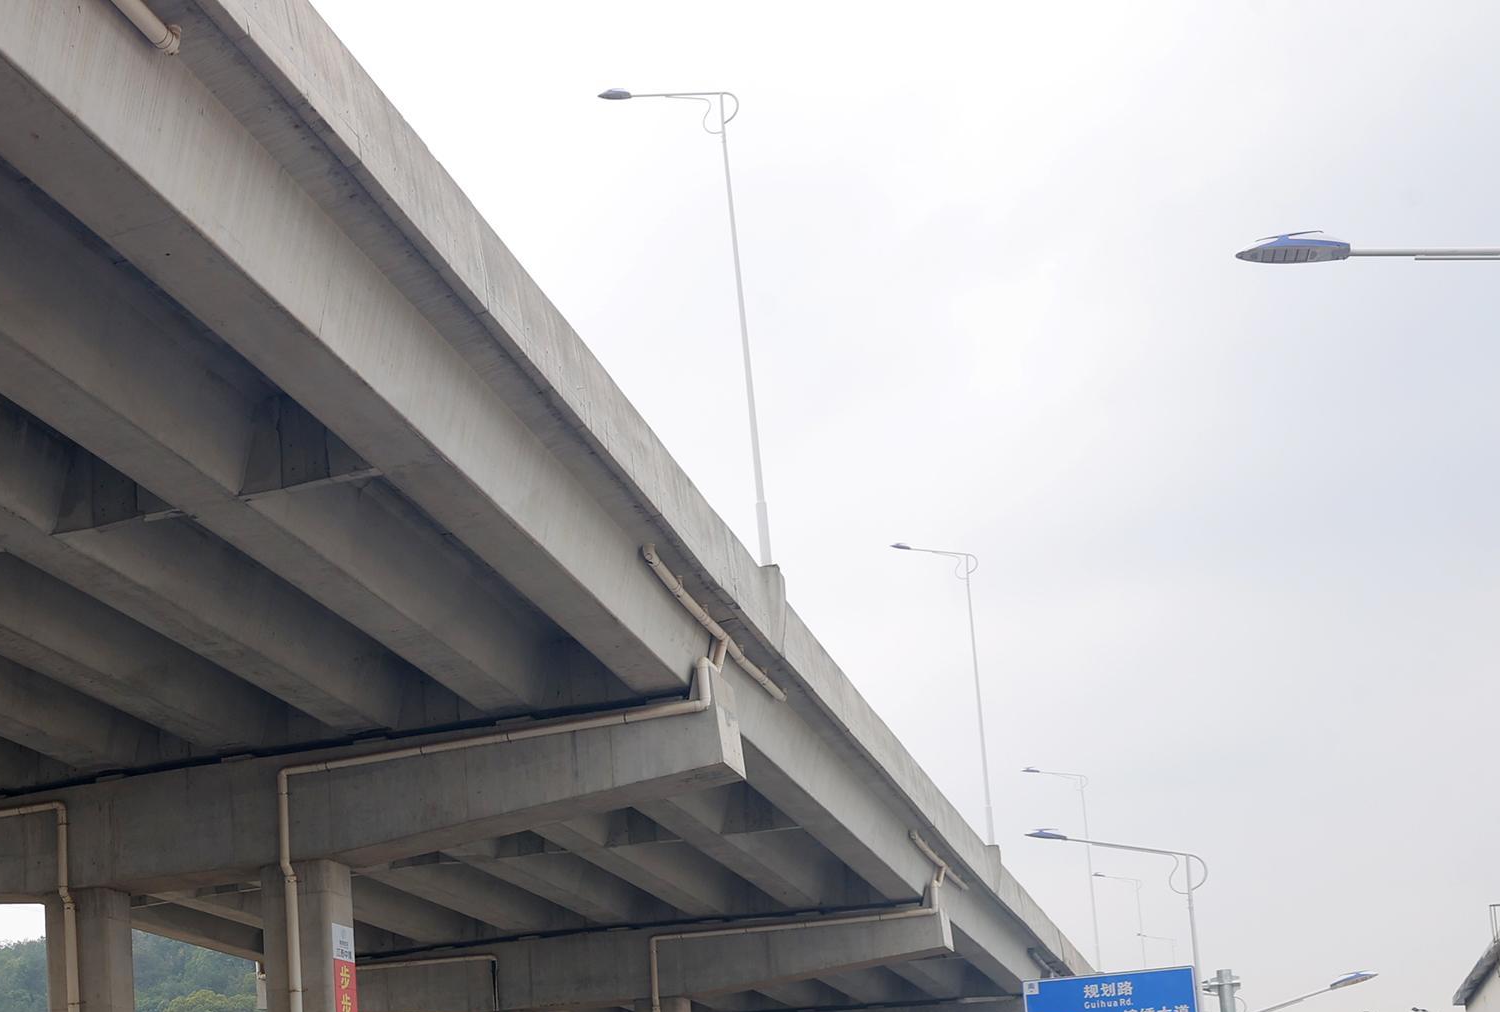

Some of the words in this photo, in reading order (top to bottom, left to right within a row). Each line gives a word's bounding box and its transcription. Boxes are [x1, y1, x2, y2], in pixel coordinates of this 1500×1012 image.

[1083, 981, 1133, 999] 规划路
[1084, 1000, 1118, 1009] Guihua
[1119, 998, 1134, 1007] Rd.
